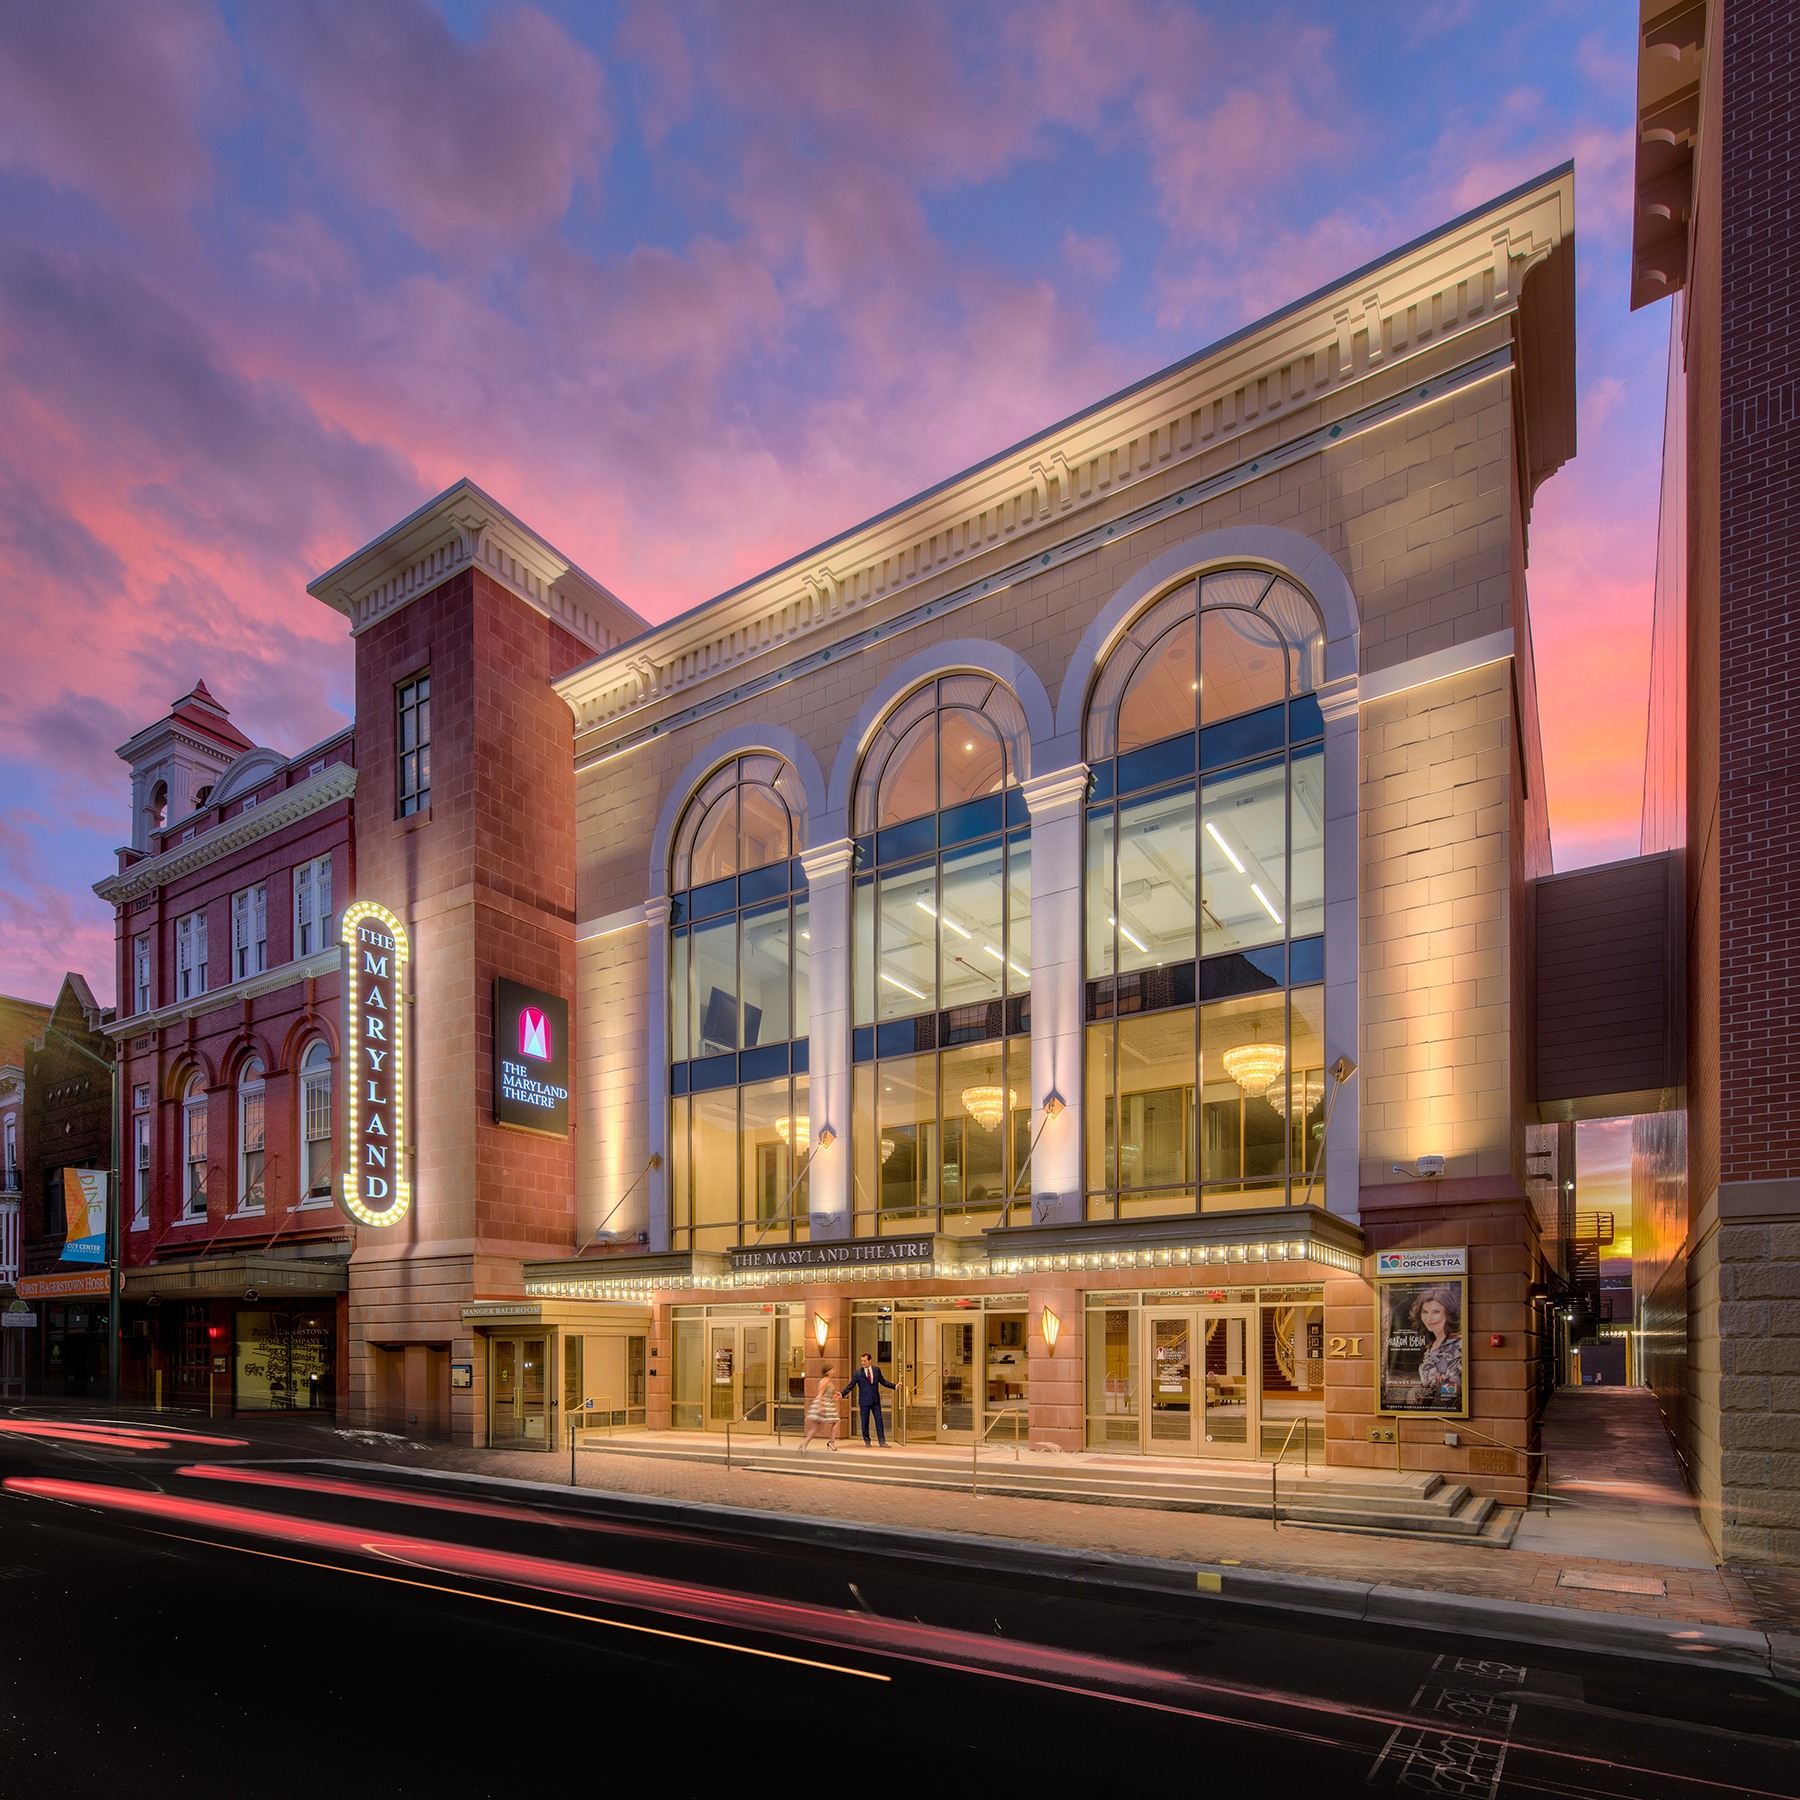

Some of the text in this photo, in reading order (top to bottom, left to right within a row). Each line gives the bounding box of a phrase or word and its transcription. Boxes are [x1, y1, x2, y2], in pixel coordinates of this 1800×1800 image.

[358, 927, 394, 951] THE
[363, 950, 388, 1198] MARYLAND
[502, 1061, 527, 1077] THE
[502, 1086, 554, 1108] THEATRE
[503, 1074, 568, 1099] MARYLAND
[79, 1175, 104, 1214] DINE
[733, 1243, 929, 1267] THE MARYLAND THEATRE
[1403, 1259, 1460, 1267] ORCHESTRA
[21, 1282, 38, 1294] FIRST
[39, 1279, 84, 1294] HAGERSTOWN
[85, 1277, 104, 1290] HOSE
[1329, 1337, 1363, 1358] 21
[1482, 1451, 1505, 1459] 1915
[1480, 1463, 1505, 1472] 2019
